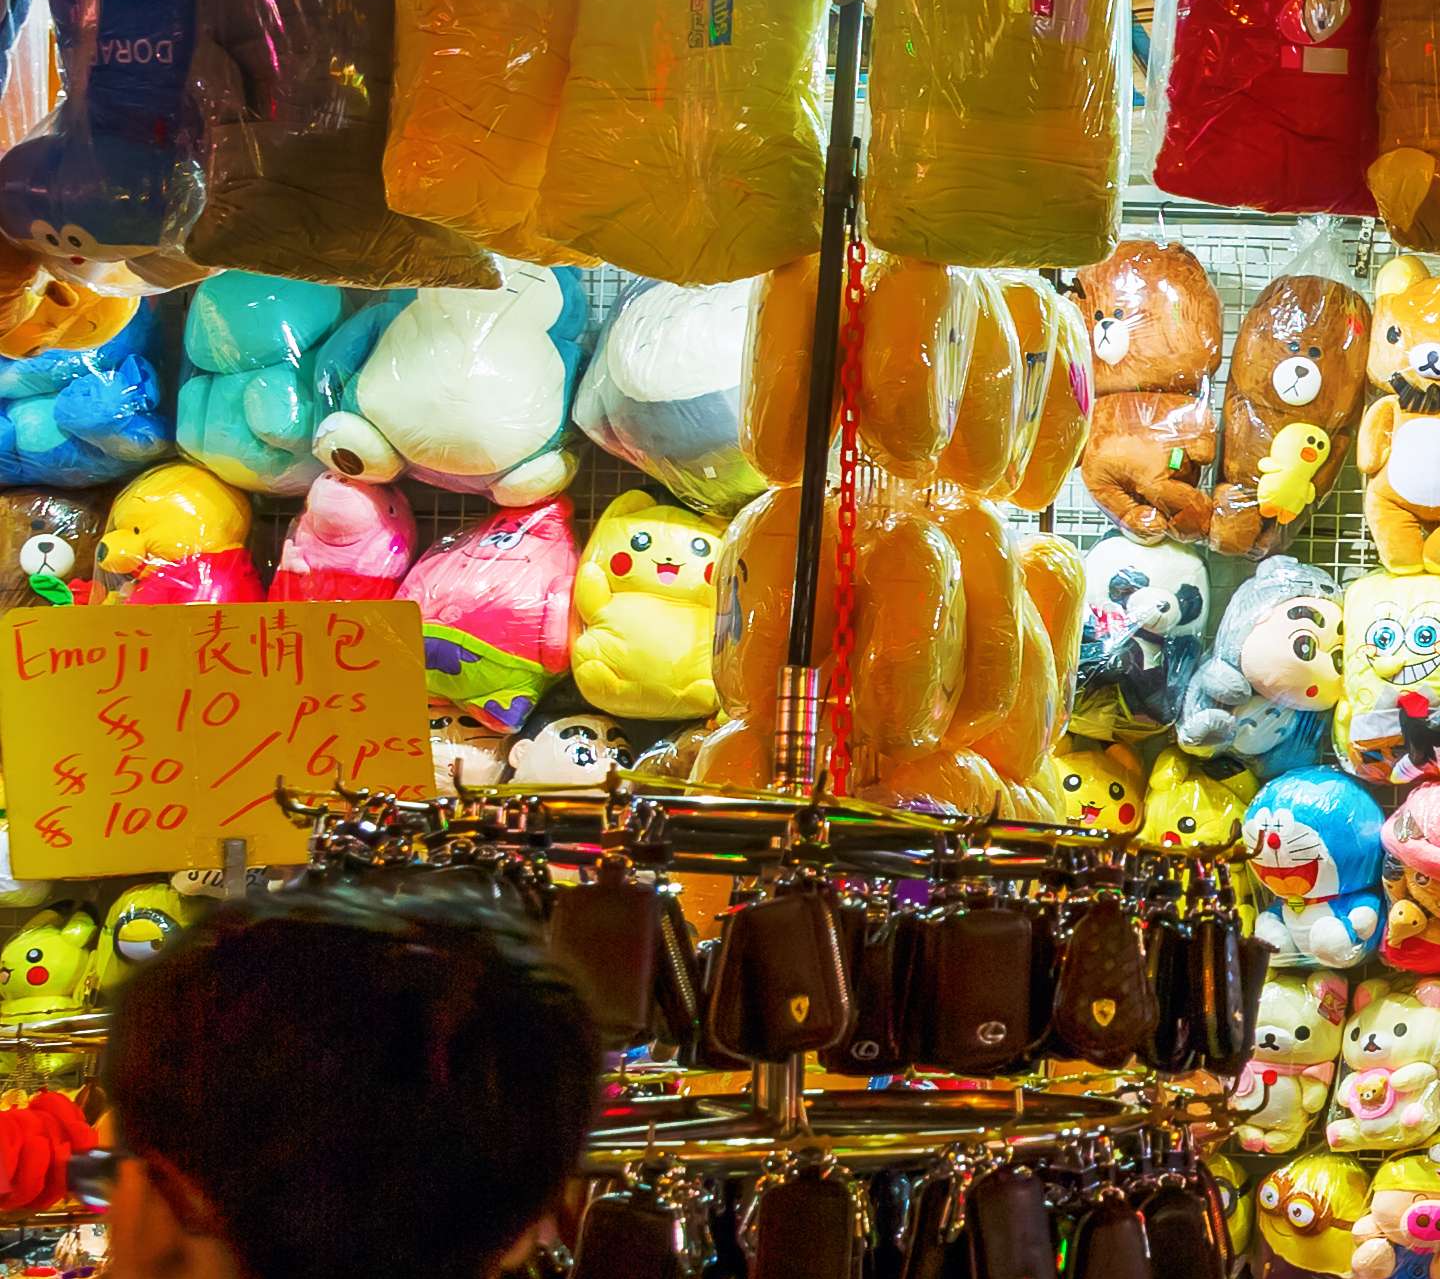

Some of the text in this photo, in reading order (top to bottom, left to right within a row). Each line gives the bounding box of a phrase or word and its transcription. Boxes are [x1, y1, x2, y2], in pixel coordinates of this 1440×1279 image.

[13, 609, 380, 693] Emoji 表情包
